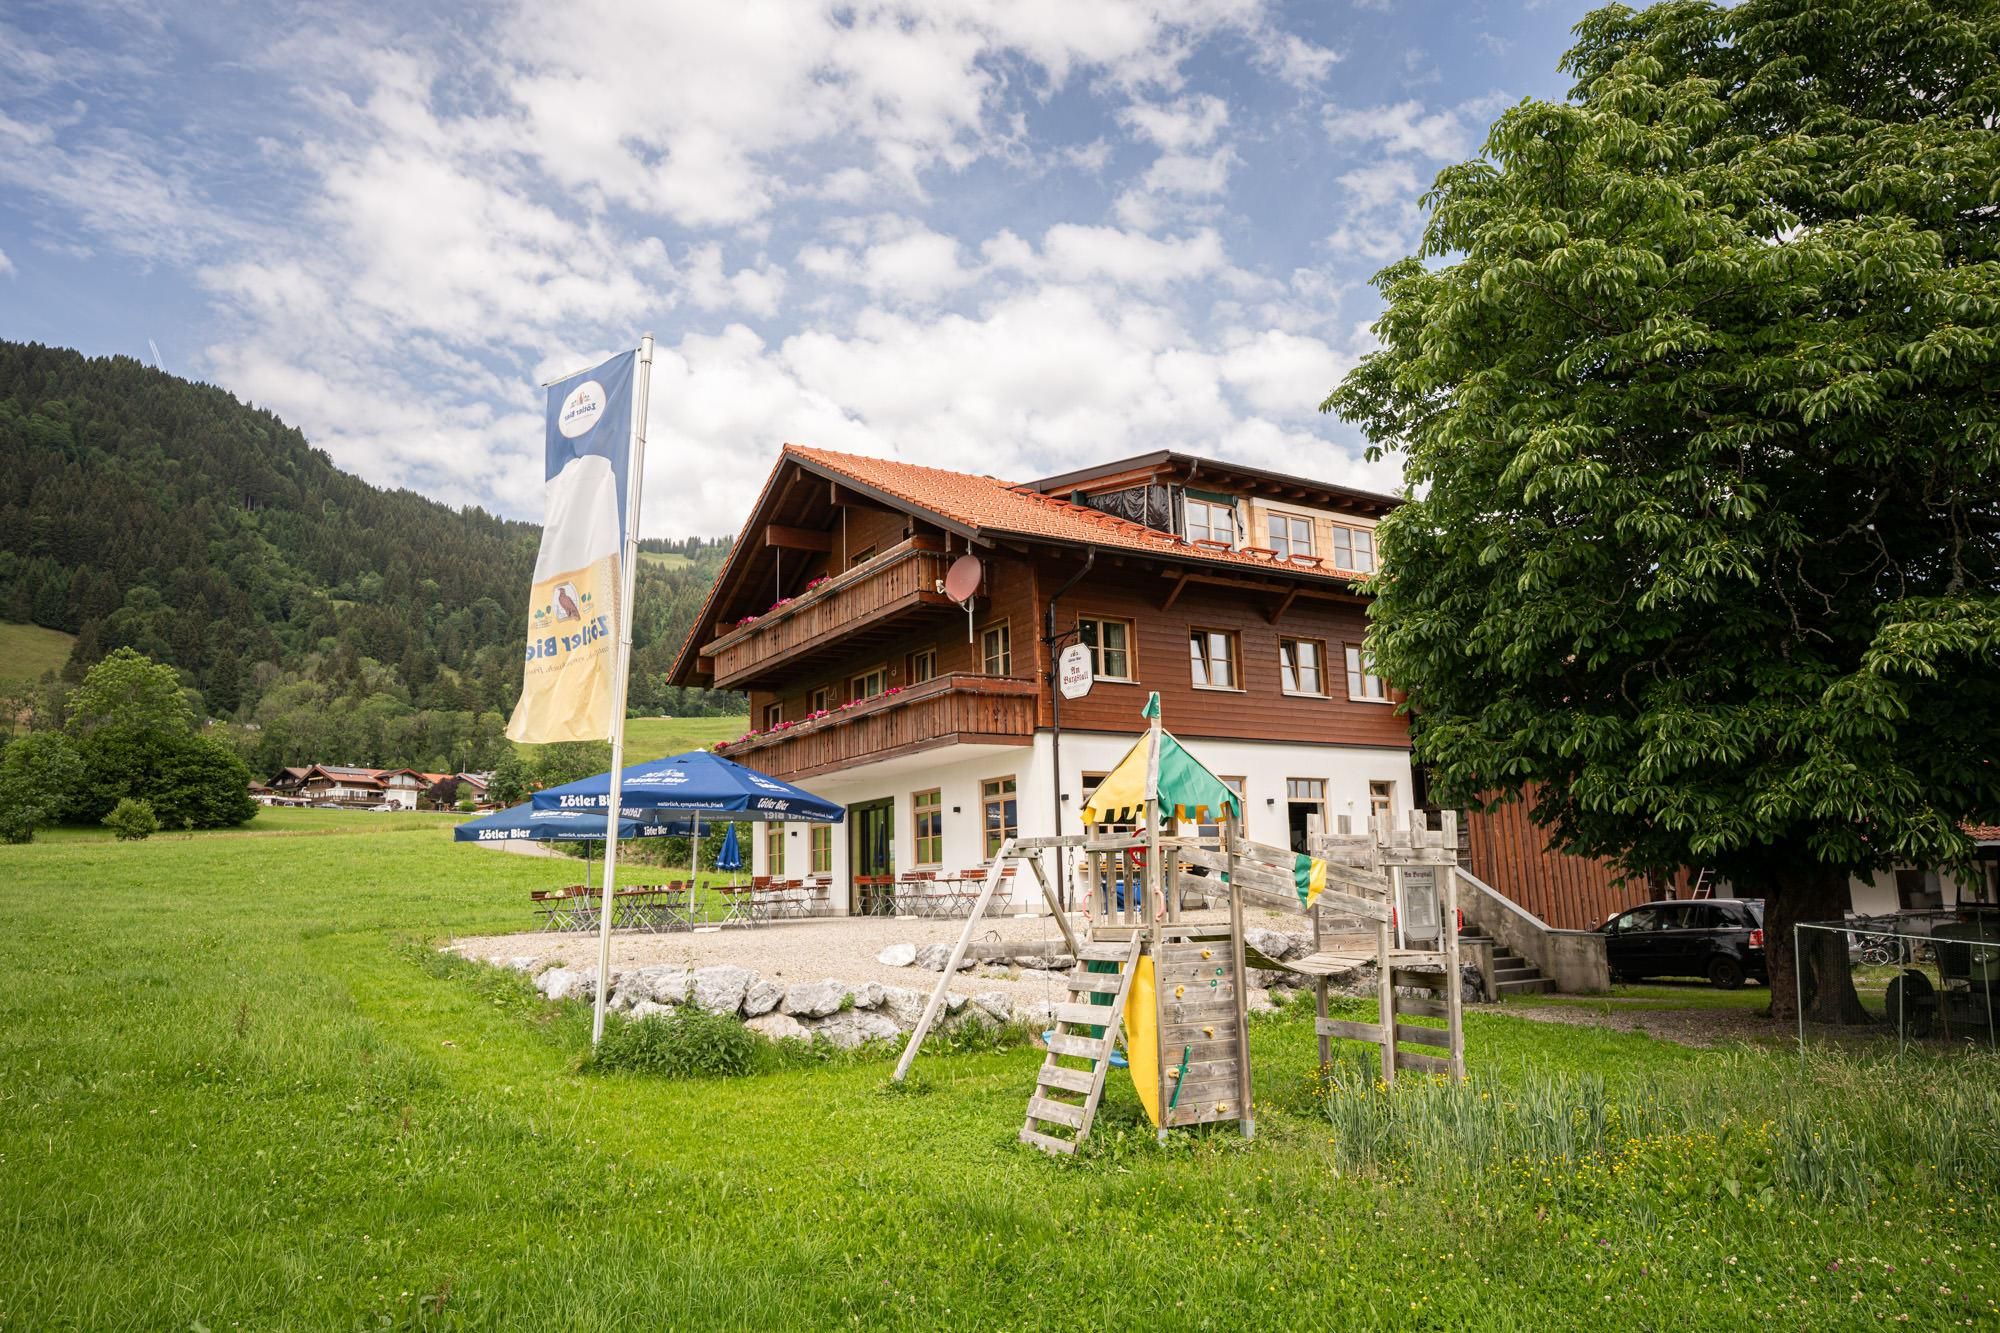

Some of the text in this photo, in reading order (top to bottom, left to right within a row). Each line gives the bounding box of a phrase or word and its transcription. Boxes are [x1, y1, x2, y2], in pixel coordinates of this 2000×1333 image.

[1064, 671, 1088, 684] Burgstall
[560, 794, 623, 808] Zötler Bir
[757, 798, 789, 810] Zötler Bier
[478, 828, 531, 840] Zötler Bier
[643, 826, 658, 836] Zötler
[657, 825, 668, 835] Bier
